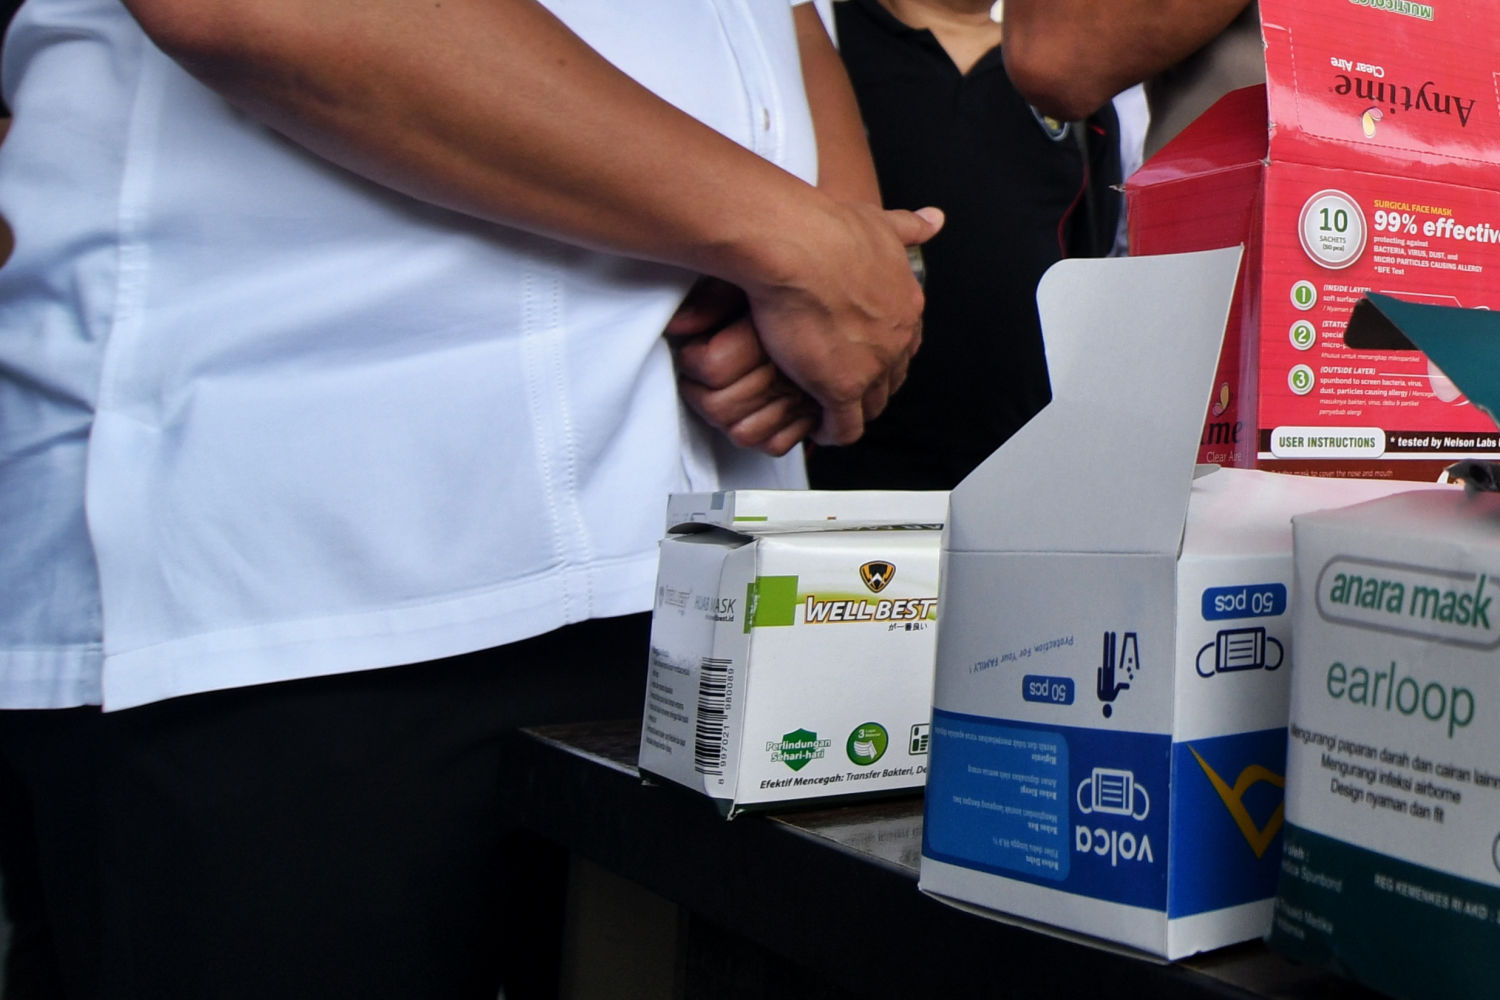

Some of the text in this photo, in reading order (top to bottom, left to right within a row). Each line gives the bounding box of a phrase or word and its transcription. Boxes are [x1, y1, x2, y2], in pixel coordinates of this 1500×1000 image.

[1331, 57, 1385, 78] Clear Aire
[1334, 74, 1476, 128] Anytime
[1374, 200, 1453, 217] SURGICAL FACE MASK
[1319, 207, 1348, 232] 10
[1374, 211, 1418, 235] 99%
[1319, 236, 1347, 245] SACHETS
[1373, 236, 1429, 248] protecting against
[1373, 245, 1407, 255] BACTERIA,
[1407, 249, 1428, 258] VIRUS,
[1429, 250, 1446, 260] DUST,
[1373, 255, 1483, 272] MICRO PARTICLES CAUSING ALLERGY
[1392, 267, 1405, 275] Test
[1297, 327, 1307, 343] 2
[1295, 371, 1306, 387] 3
[1320, 377, 1352, 385] spunbond
[1364, 389, 1388, 397] causing
[1389, 389, 1408, 398] allergy
[1279, 436, 1376, 449] USER INSTRUCTIONS
[1398, 436, 1429, 448] tested
[1431, 436, 1442, 450] by
[1443, 436, 1474, 448] Nelson
[1476, 437, 1497, 448] Labs
[1206, 451, 1228, 464] Clear
[805, 596, 938, 624] WELL BEST
[1214, 590, 1274, 614] 50 pcs
[1330, 572, 1492, 631] anara mask
[973, 635, 1075, 673] Protection For Your FAMILY
[1029, 680, 1067, 703] 50 pcs
[1326, 661, 1475, 739] earloop
[858, 729, 865, 739] 3
[720, 724, 731, 768] 997021
[766, 739, 832, 752] Perlindungan
[771, 749, 825, 763] Sehari-hari
[1338, 739, 1378, 760] paparan
[1379, 748, 1410, 770] darah
[1411, 755, 1433, 774] dan
[1435, 762, 1471, 782] cairan
[760, 767, 915, 790] Efektif Mencegah: Transfer Bakteri,
[1321, 753, 1462, 804] Mengurangi infeksi airborne
[1330, 778, 1445, 824] Design nyaman dan fit
[1075, 824, 1154, 867] volca
